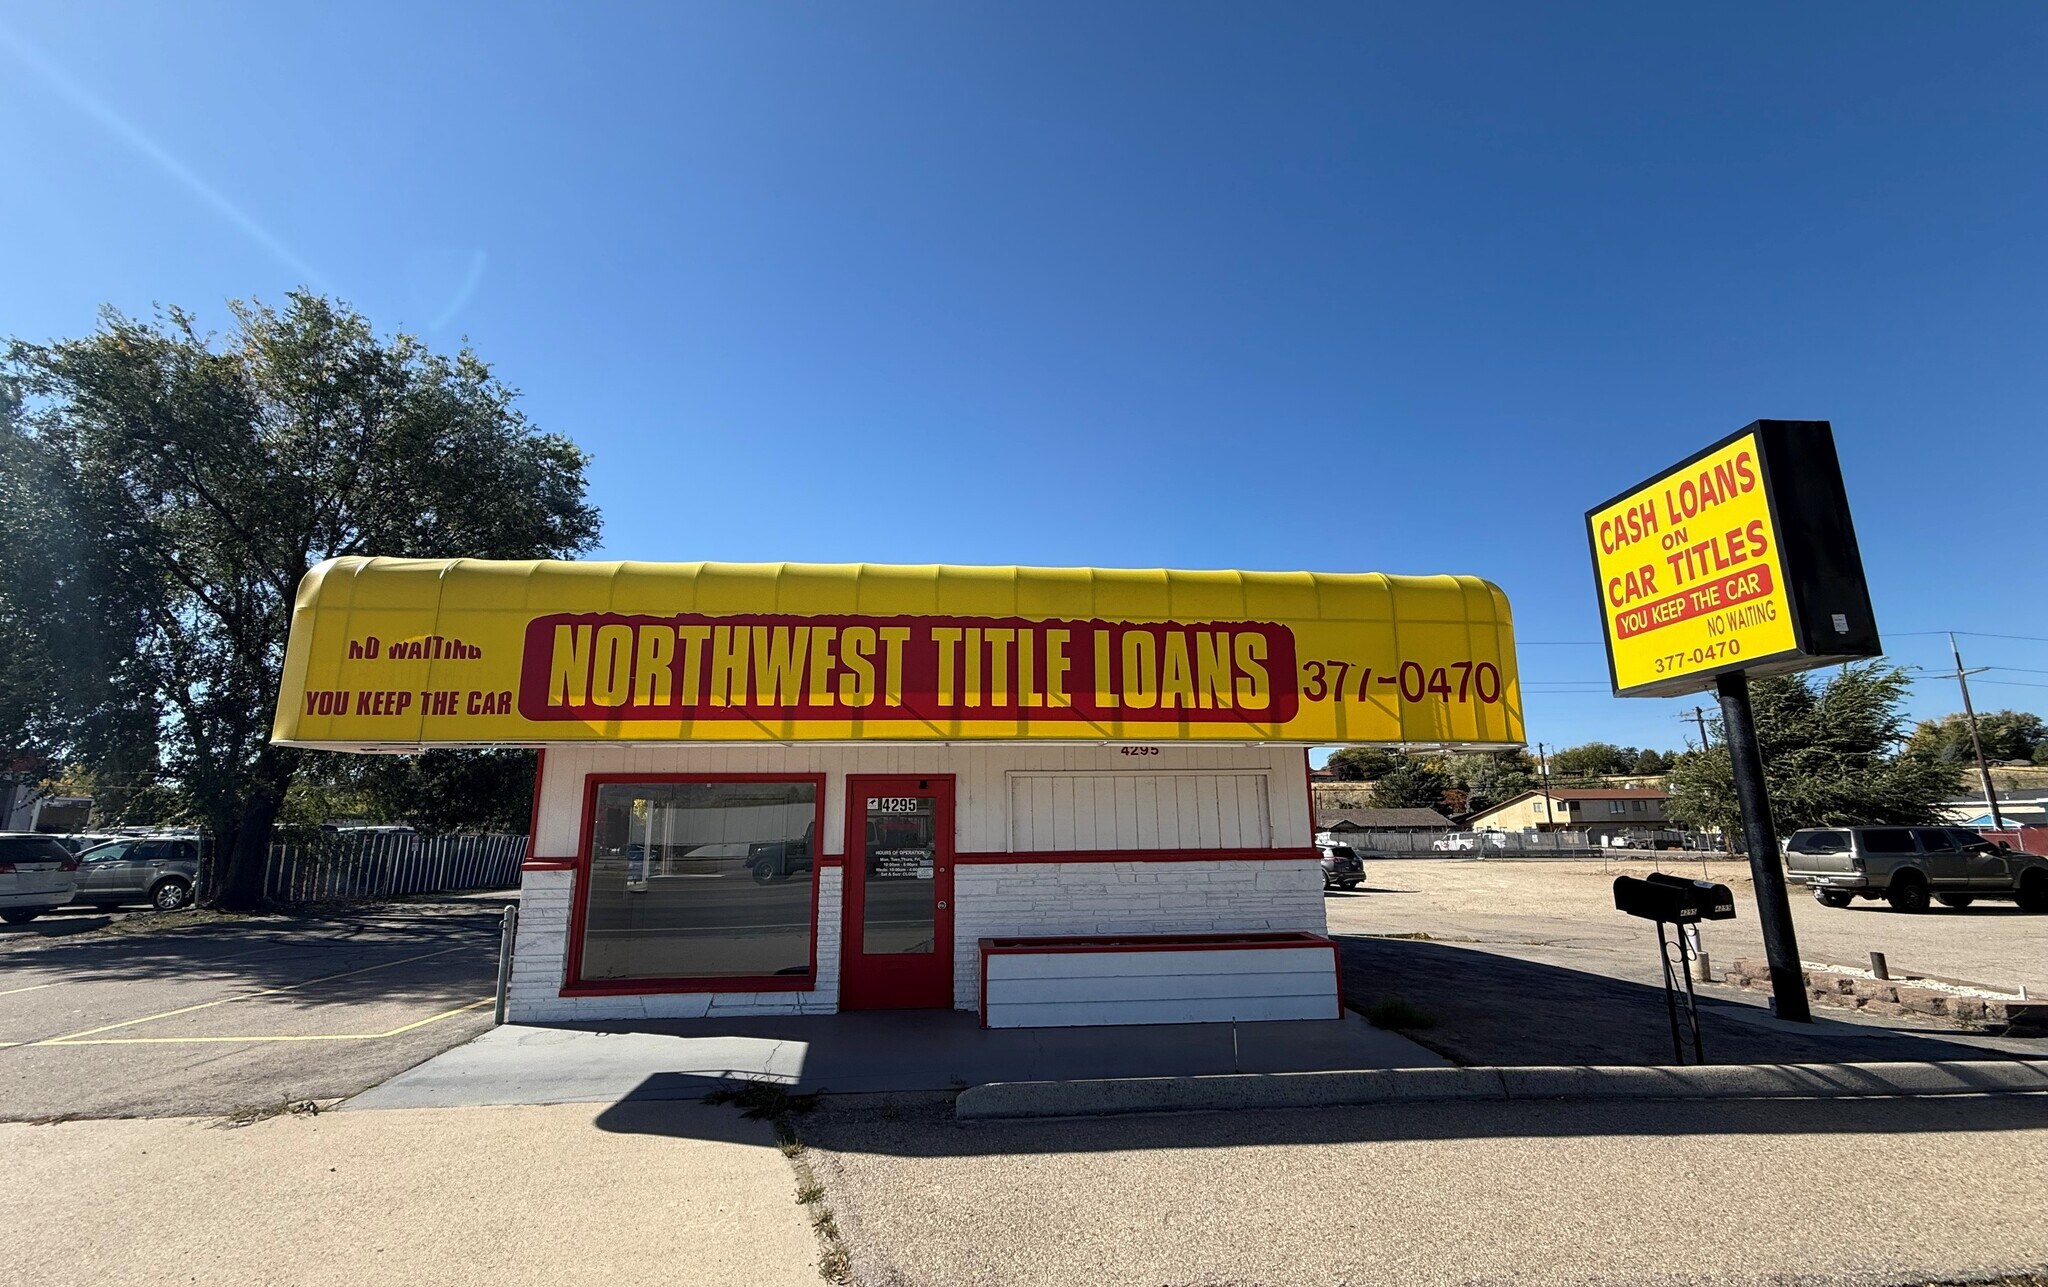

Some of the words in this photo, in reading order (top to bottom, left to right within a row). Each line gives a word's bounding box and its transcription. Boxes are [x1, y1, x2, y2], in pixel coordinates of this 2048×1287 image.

[1600, 499, 1659, 555] CASH
[1665, 451, 1755, 525] LOANS
[1661, 527, 1688, 551] ON
[1609, 564, 1658, 607] CAR
[1666, 520, 1768, 586] TITLES
[1620, 610, 1648, 633] YOU
[1652, 598, 1686, 624] KEEP
[1690, 586, 1721, 611] THE
[1725, 573, 1761, 600] CAR
[1707, 615, 1725, 638] NO
[1726, 600, 1776, 632] WAITING
[547, 624, 911, 707] NORTHWEST
[931, 627, 1072, 708] TITLE
[1094, 630, 1270, 710] LOANS
[1654, 639, 1740, 673] 377-0470
[1303, 660, 1500, 704] 377-0470
[306, 691, 350, 715] YOU
[355, 691, 412, 715] KEEP
[420, 691, 460, 715] THE
[466, 691, 513, 715] CAR
[1121, 746, 1159, 756] 4295
[882, 798, 916, 811] 4295
